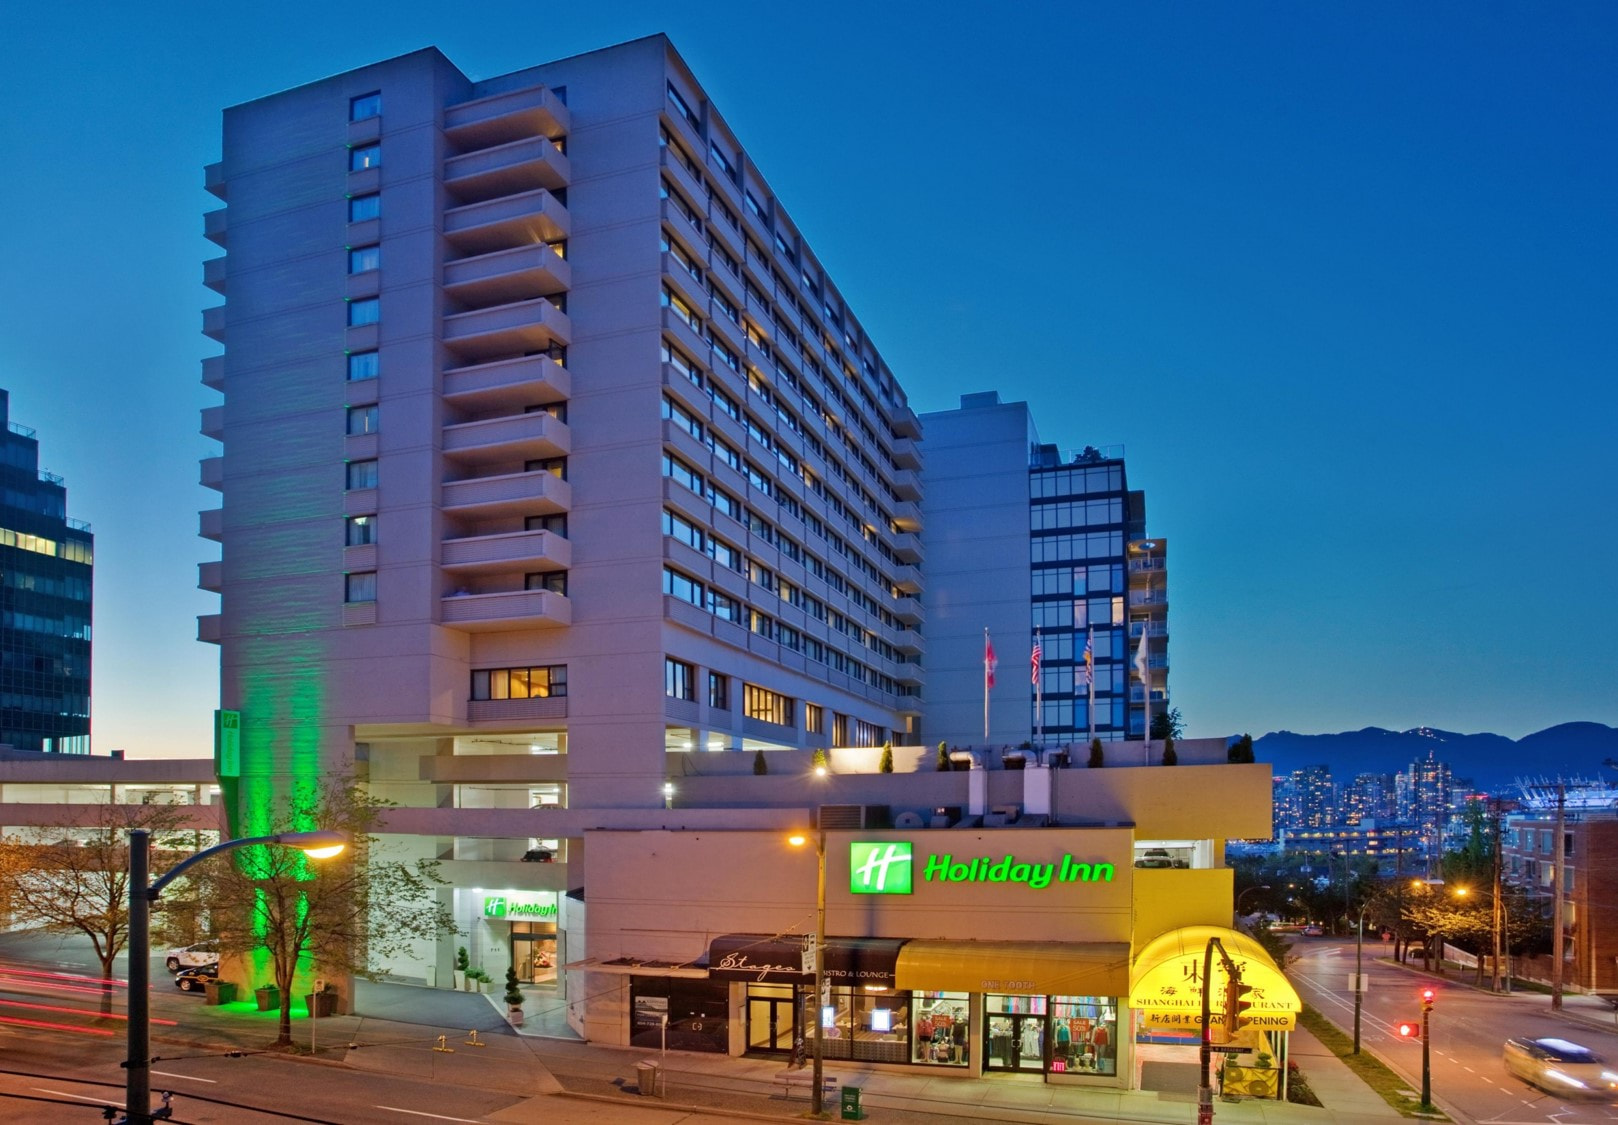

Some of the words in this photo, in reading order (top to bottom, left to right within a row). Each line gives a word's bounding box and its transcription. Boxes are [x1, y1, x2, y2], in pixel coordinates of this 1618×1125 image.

[923, 854, 1053, 889] Holiday
[1058, 854, 1115, 882] Inn
[508, 902, 549, 916] Holiday
[717, 951, 796, 982] Stages
[856, 970, 889, 979] LOUNGE
[981, 980, 1000, 989] ONE
[1004, 980, 1036, 990] TOOTH
[1136, 999, 1194, 1007] SHANGHAI
[1216, 1000, 1293, 1010] RURANT
[1247, 1016, 1289, 1026] PENING
